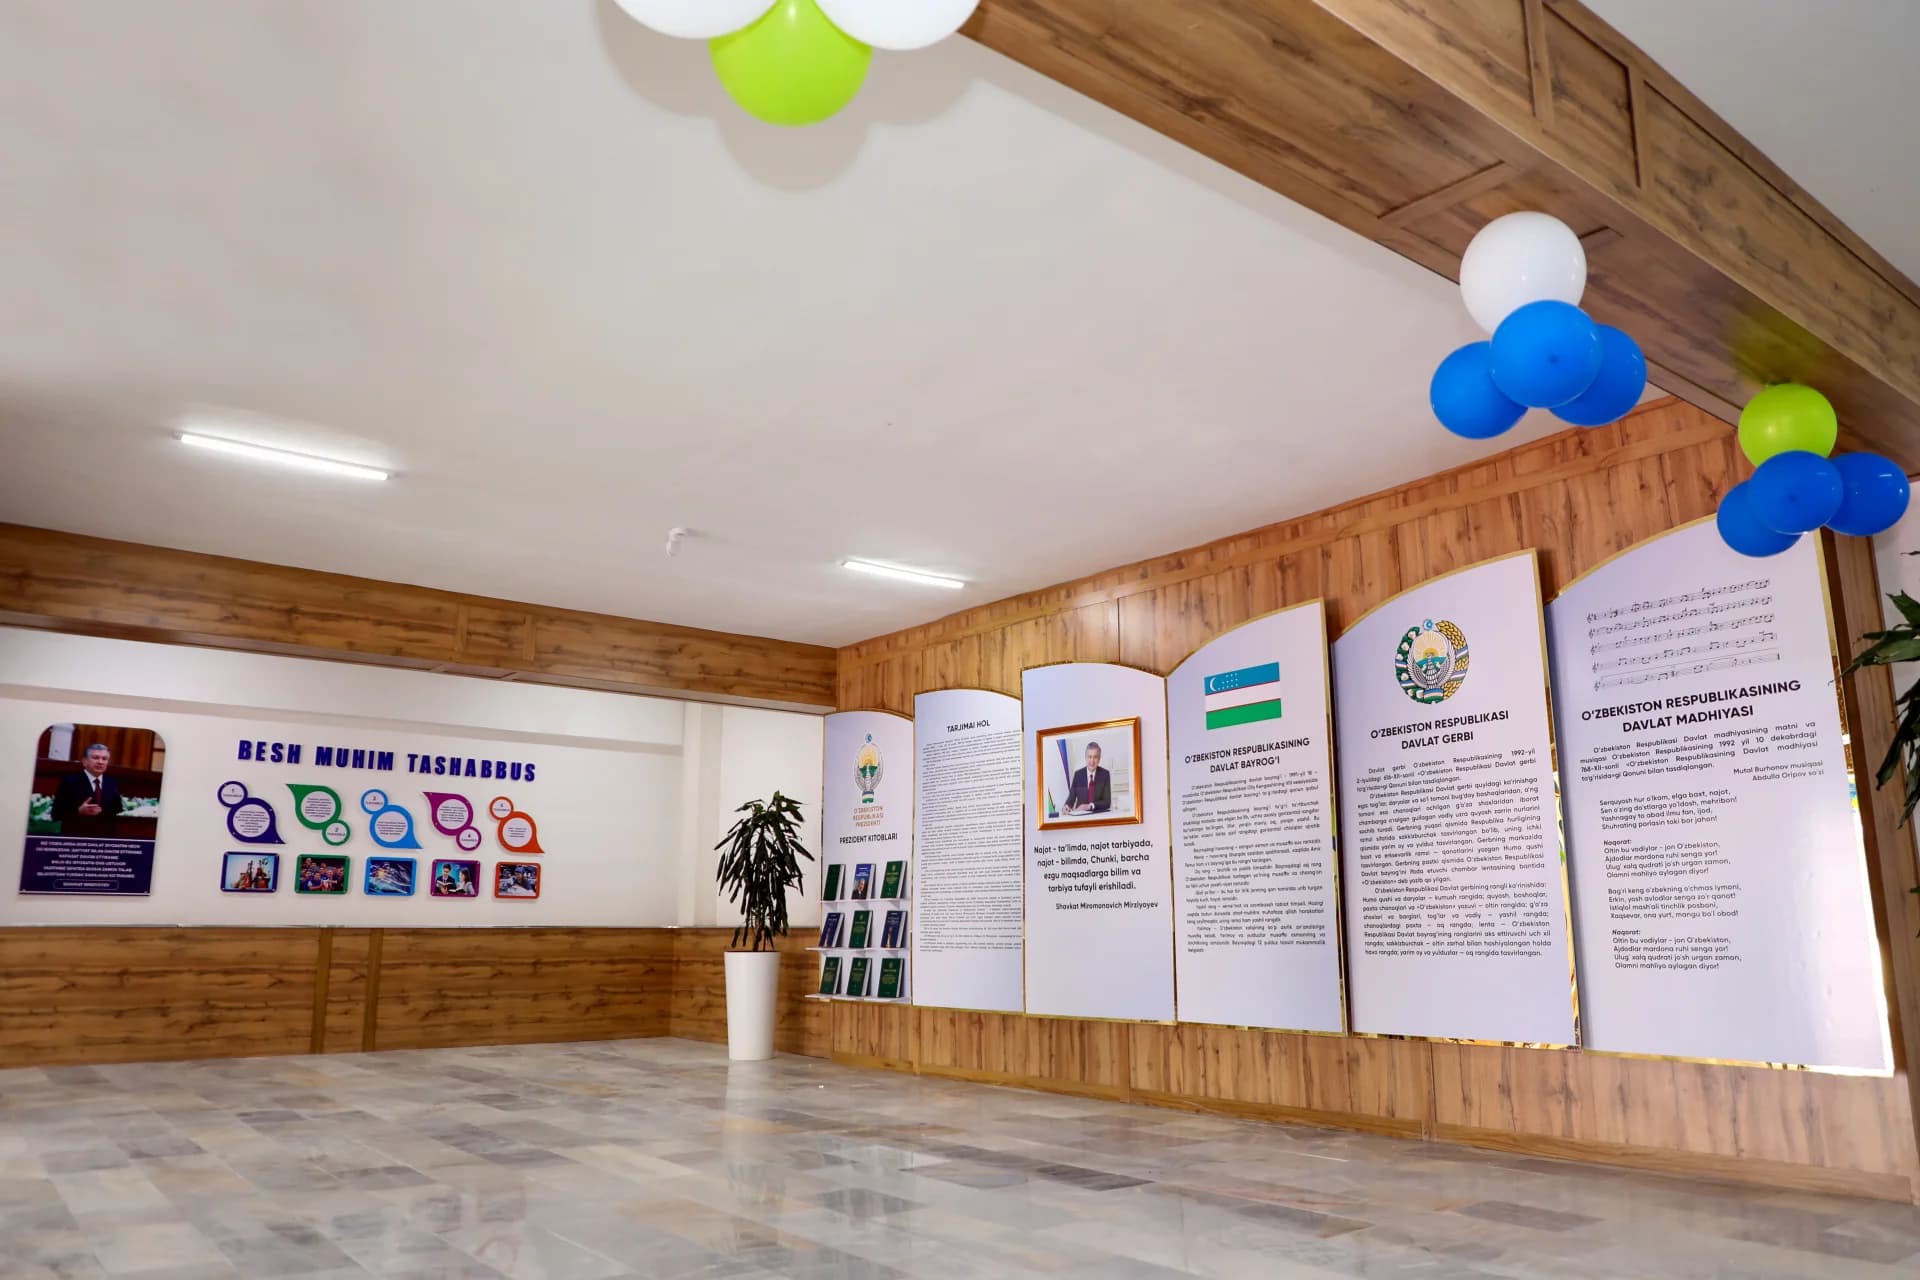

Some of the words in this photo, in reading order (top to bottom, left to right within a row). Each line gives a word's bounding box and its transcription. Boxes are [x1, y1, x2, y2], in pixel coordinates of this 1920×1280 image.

[1582, 700, 1662, 720] O'ZBEKISTON
[1666, 680, 1800, 709] RESPUBLIKASINING
[947, 722, 975, 732] TARJIMAI
[977, 720, 990, 728] HOL
[1370, 721, 1432, 738] O'ZBEKISTON
[1435, 710, 1509, 729] RESPUBLIKASI
[1623, 716, 1672, 732] DAVLAT
[1676, 705, 1754, 726] MADHIYASI
[1402, 736, 1439, 749] DAVLAT
[1442, 731, 1473, 744] GERBI
[1593, 745, 1631, 754] O'zbekiston
[1636, 737, 1678, 748] Respublikasi
[1684, 734, 1707, 743] Davlat
[1714, 728, 1768, 738] madhiyasining
[1775, 722, 1798, 731] matni
[1612, 752, 1650, 760] O'zbekiston
[1656, 744, 1714, 755] Respublikasining
[1741, 738, 1750, 746] yil
[1770, 731, 1817, 742] dekabrdagi
[1185, 749, 1230, 763] O'ZBEKISTON
[1233, 738, 1310, 756] RESPUBLIKASINING
[1676, 751, 1736, 762] Respublikasining
[1743, 746, 1769, 755] Davlat
[1777, 741, 1818, 751] madhiyasi
[238, 740, 301, 764] BESH
[315, 746, 393, 770] MUHIM
[408, 754, 536, 782] TASHABBUS
[1210, 761, 1239, 773] DAVLAT
[1241, 756, 1280, 769] BAYROG'I
[1623, 769, 1646, 777] Qonuni
[1782, 770, 1806, 779] Oripov
[840, 836, 866, 844] PREZIDENT
[868, 833, 898, 842] KITOBLARI
[1034, 845, 1052, 855] Najot
[1058, 843, 1089, 852] ta'limda,
[1091, 842, 1110, 852] najot
[1112, 839, 1153, 850] tarbiyada,
[1037, 859, 1054, 869] najot
[1061, 857, 1089, 866] bilimda,
[1091, 854, 1119, 864] Chunki,
[1121, 853, 1149, 862] barcha
[1044, 873, 1060, 881] ezgu
[1061, 869, 1109, 880] maqsadlarga
[1110, 868, 1129, 876] bilim
[1048, 884, 1073, 894] tarbiya
[1074, 882, 1097, 893] tufayli
[1099, 881, 1136, 891] erishiladi.
